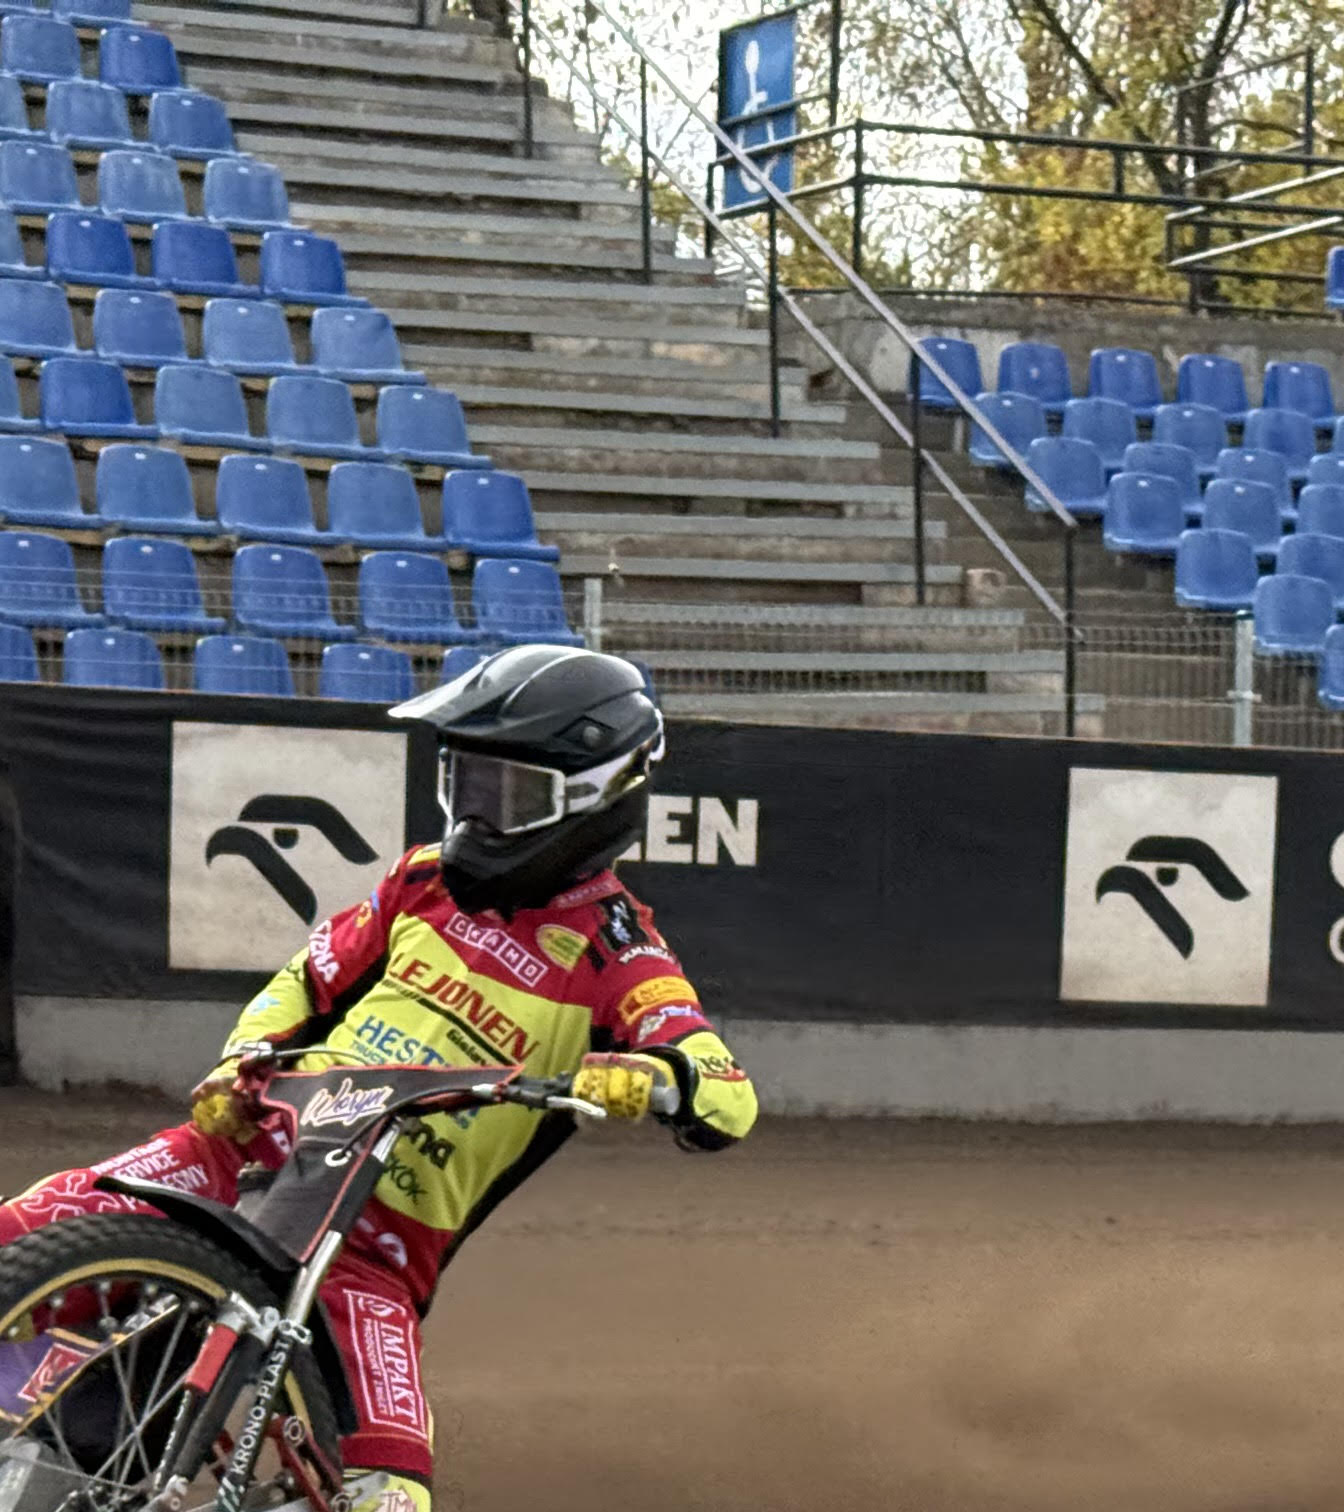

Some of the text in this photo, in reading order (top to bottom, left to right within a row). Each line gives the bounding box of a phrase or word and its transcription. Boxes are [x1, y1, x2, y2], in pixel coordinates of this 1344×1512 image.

[614, 792, 759, 866] EN
[356, 1015, 452, 1067] HEST
[388, 953, 540, 1063] LEJONEN
[111, 1149, 180, 1181] ERVICE
[229, 1339, 290, 1475] KRONO-PLAST
[381, 1321, 418, 1427] IMPAKT
